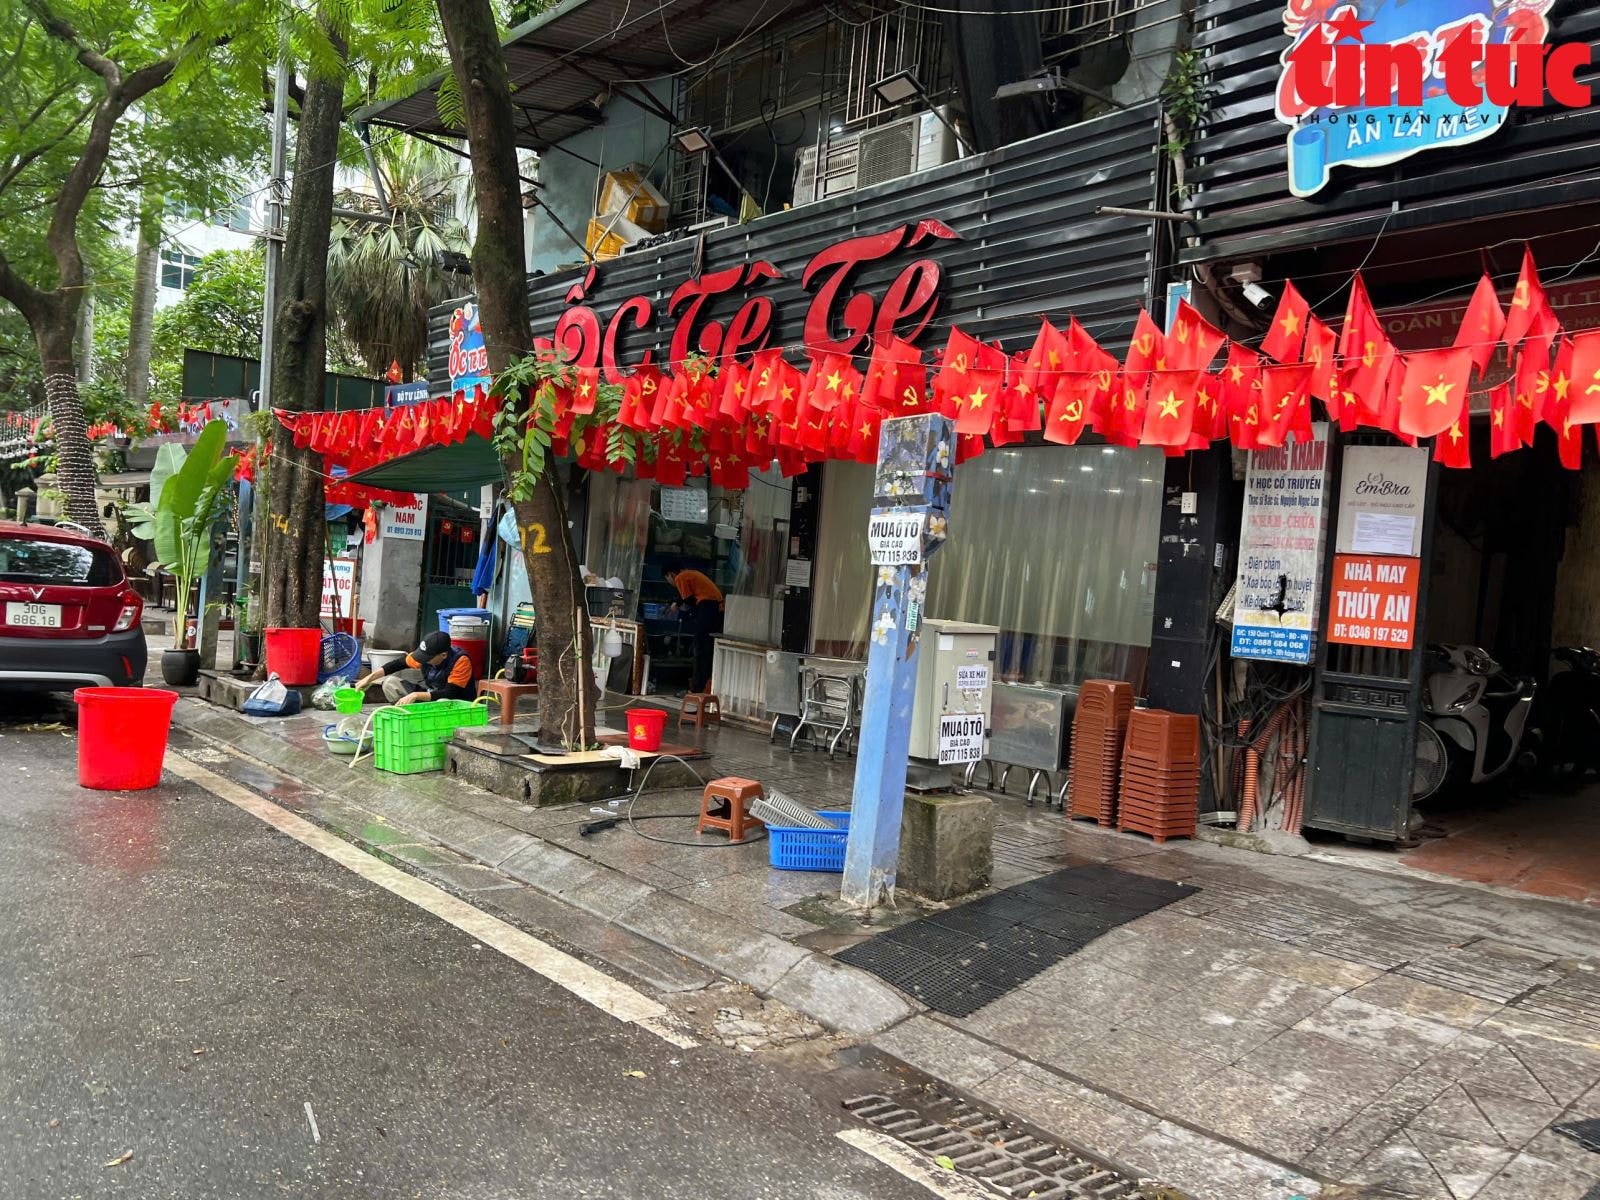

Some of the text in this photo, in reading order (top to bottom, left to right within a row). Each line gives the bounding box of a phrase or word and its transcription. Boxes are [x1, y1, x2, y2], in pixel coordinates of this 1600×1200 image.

[1256, 478, 1272, 491] HỌC
[1355, 480, 1411, 496] EmBra
[396, 512, 416, 524] NAM
[888, 550, 900, 562] 115
[1344, 560, 1407, 584] NHÀ MAY
[24, 605, 46, 614] 30G
[1337, 586, 1381, 621] THÚY
[1382, 595, 1410, 623] AN
[14, 615, 55, 626] 886.18
[1334, 625, 1408, 642] ĐT: 0346 197 529
[960, 738, 970, 747] CAO
[940, 747, 980, 762] 0877 115 838
